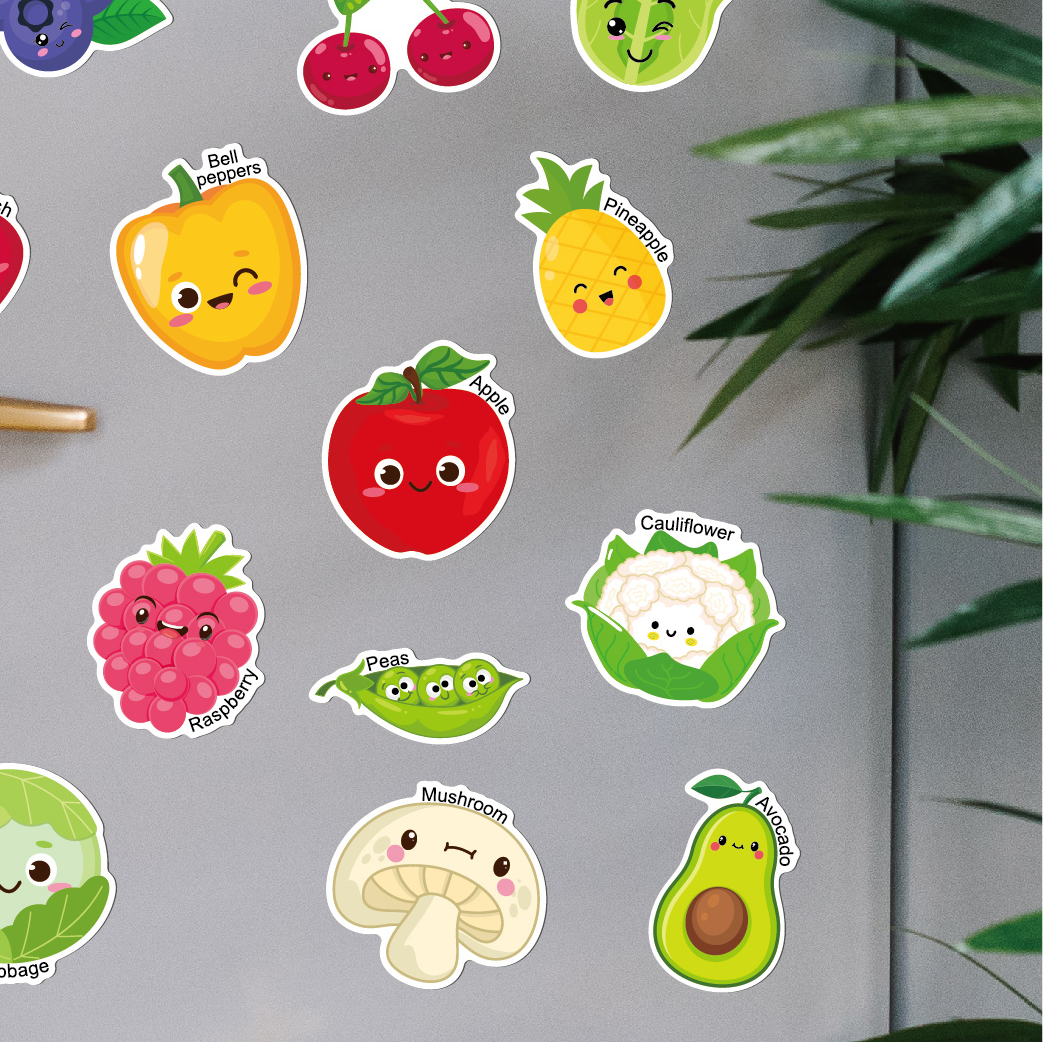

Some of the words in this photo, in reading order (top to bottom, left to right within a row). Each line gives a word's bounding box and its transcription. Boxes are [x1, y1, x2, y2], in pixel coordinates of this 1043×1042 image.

[196, 163, 262, 190] peppers
[207, 149, 239, 169] Bell
[603, 197, 668, 263] Pineapple
[468, 375, 510, 415] Apple
[640, 515, 736, 541] Cauliflower
[365, 653, 410, 672] Peas
[188, 668, 259, 733] Raspberry
[422, 786, 508, 825] Mushroom
[754, 796, 794, 867] Avocado
